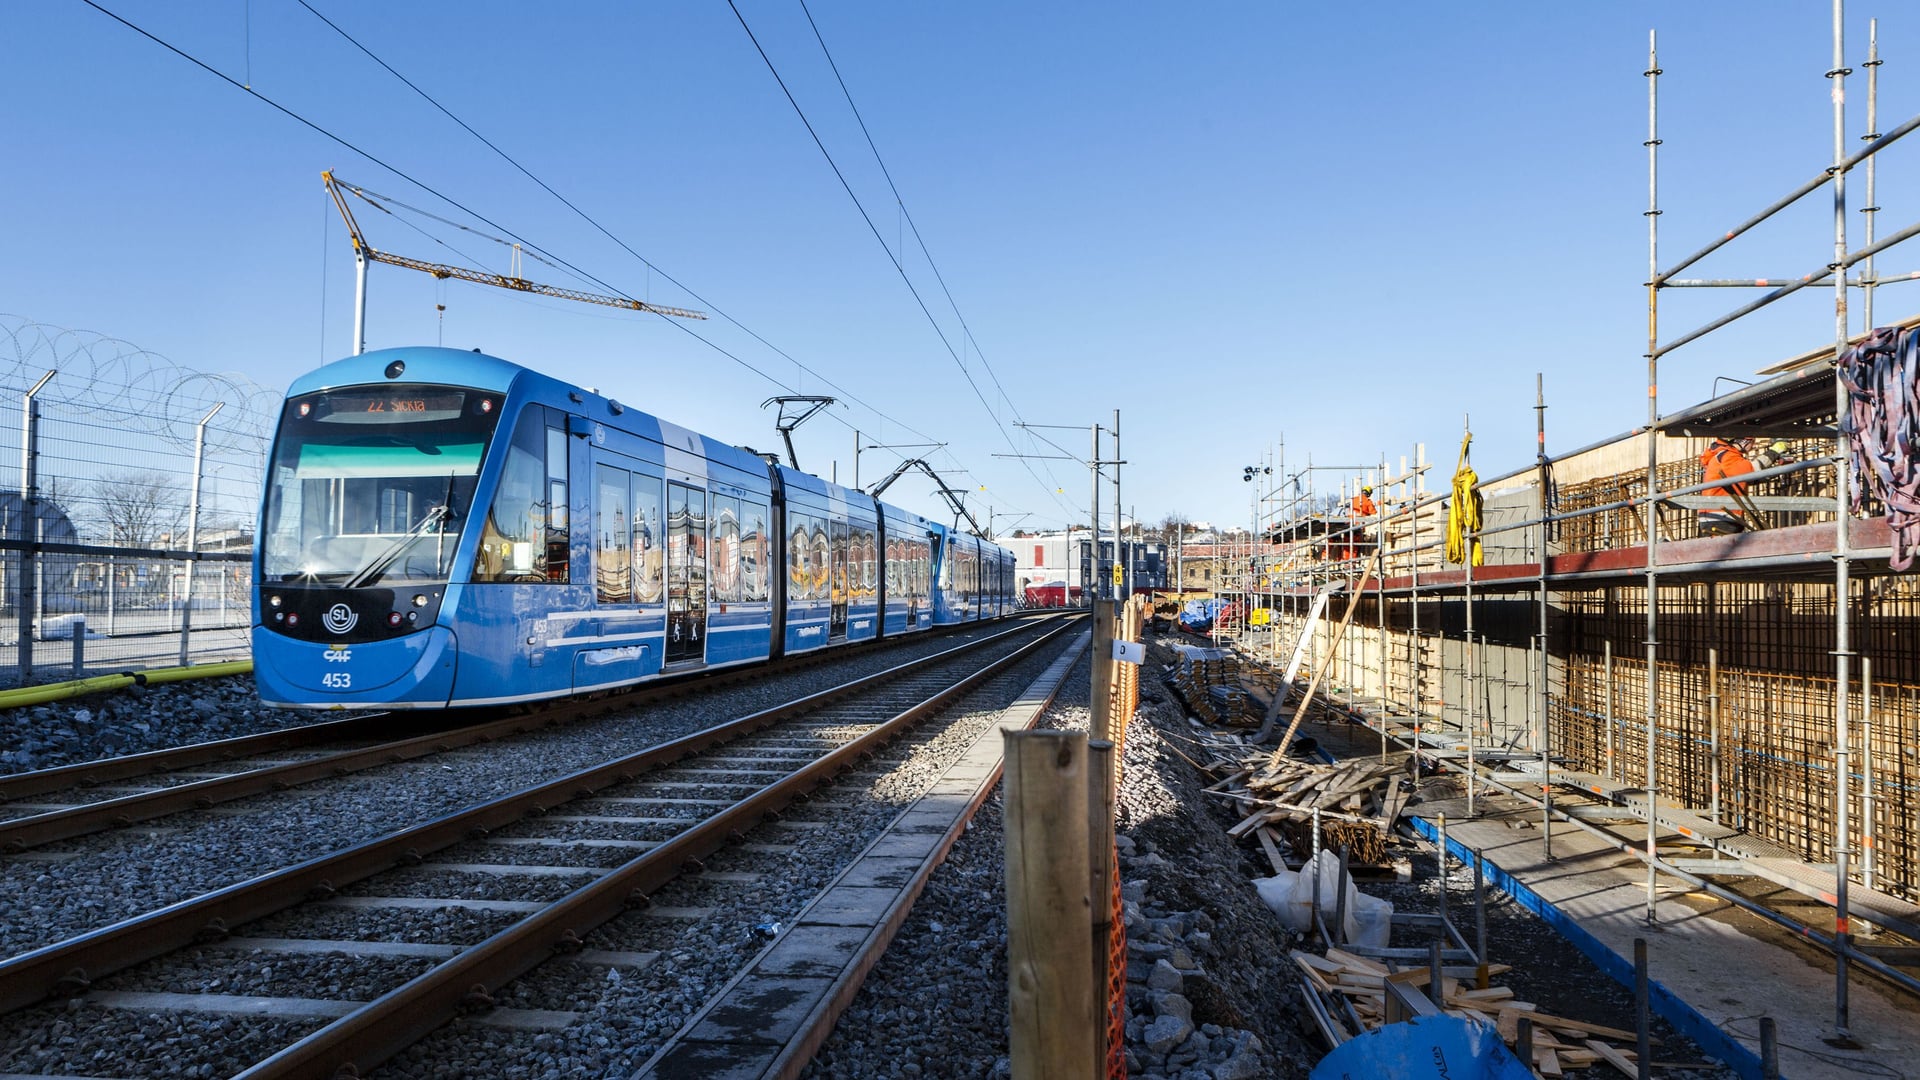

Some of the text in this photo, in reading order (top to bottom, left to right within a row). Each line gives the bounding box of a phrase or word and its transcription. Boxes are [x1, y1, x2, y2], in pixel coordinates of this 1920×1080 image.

[367, 399, 385, 412] 22
[332, 609, 348, 621] SL
[534, 620, 547, 633] 453
[323, 650, 352, 662] CAF
[322, 673, 351, 688] 453
